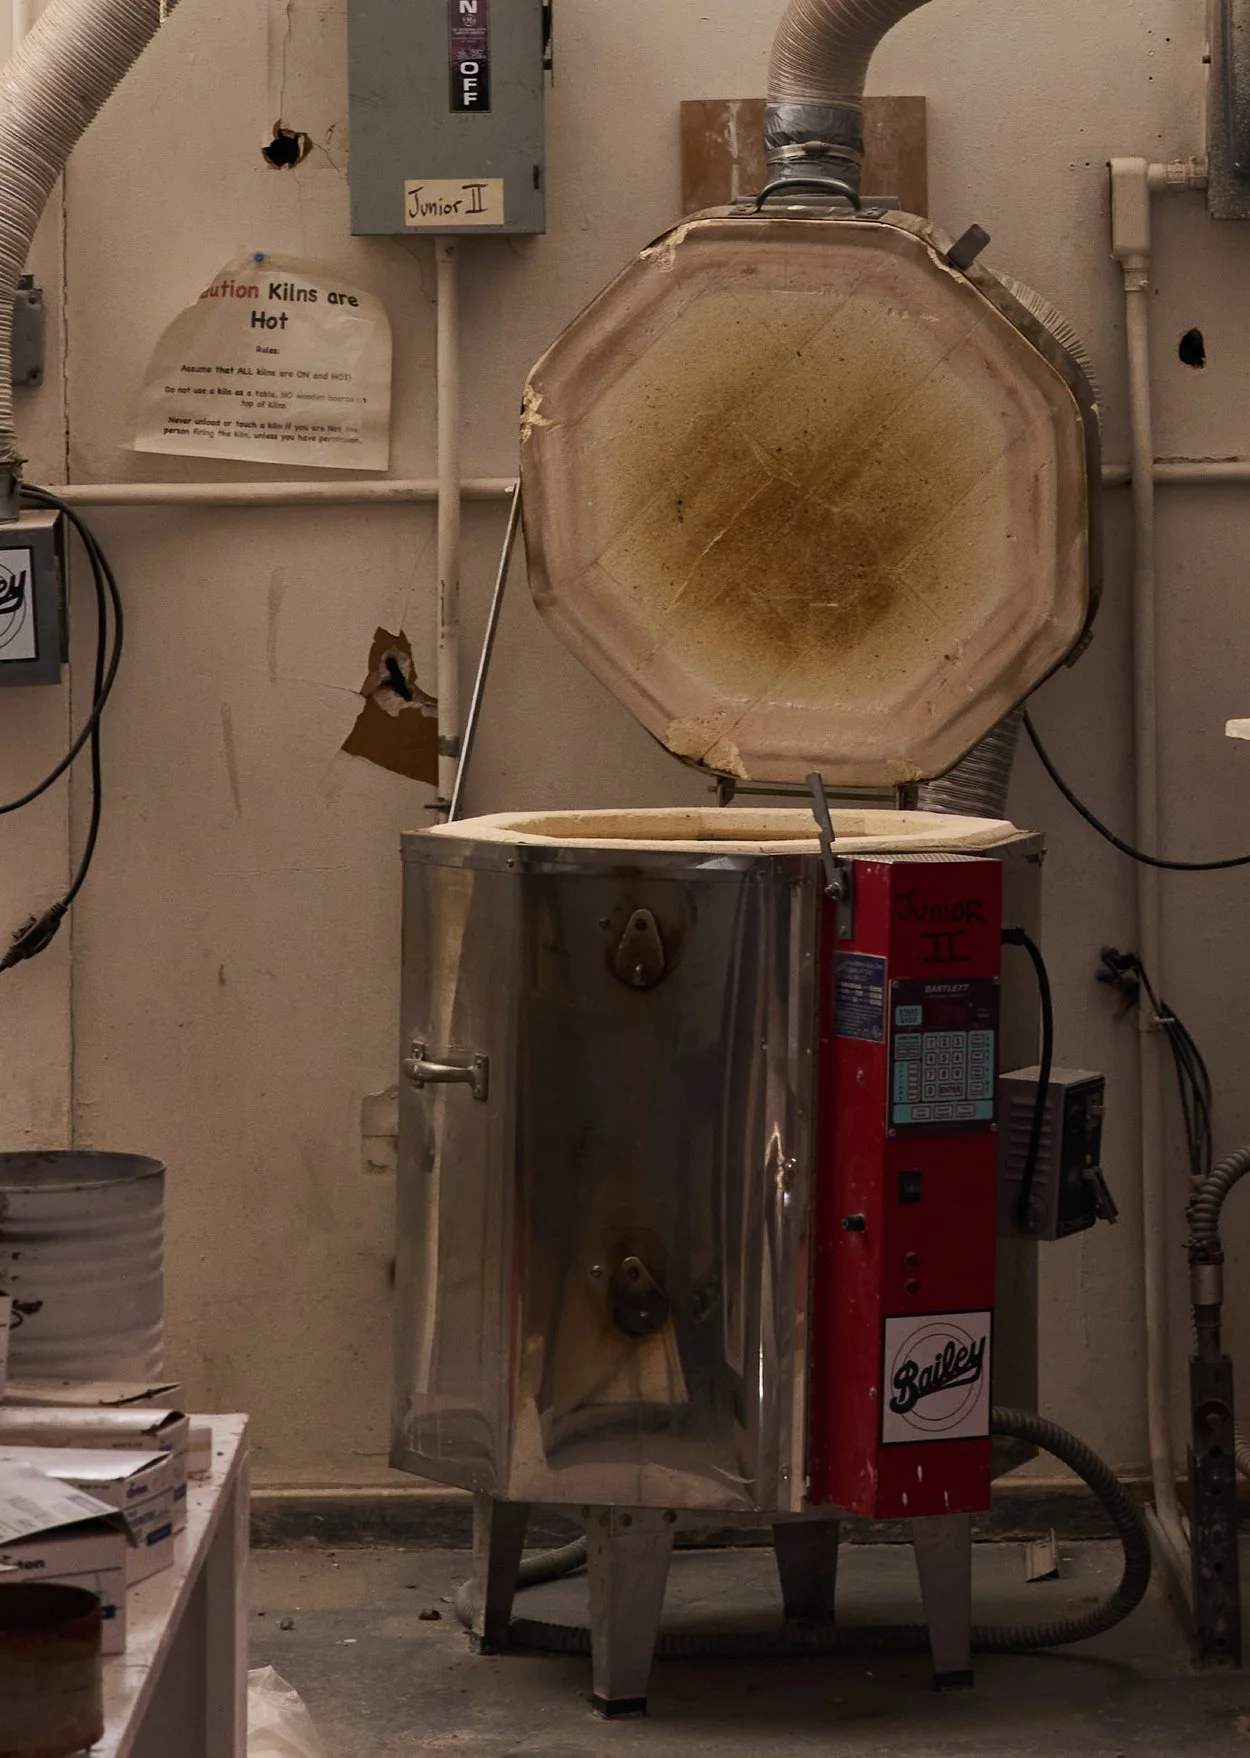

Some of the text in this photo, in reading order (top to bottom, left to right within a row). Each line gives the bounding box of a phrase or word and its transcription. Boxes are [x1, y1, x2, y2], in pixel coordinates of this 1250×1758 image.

[459, 0, 478, 14] N
[460, 61, 480, 106] OFF
[407, 184, 489, 218] Junior II
[201, 279, 360, 308] aution Kilns are
[251, 310, 289, 330] Hot
[181, 364, 213, 374] Assume
[216, 366, 234, 375] that
[237, 367, 254, 376] ALL
[256, 367, 276, 377] kilns
[296, 370, 311, 379] ON
[312, 372, 329, 380] and
[164, 385, 176, 394] Do
[217, 387, 233, 396] kiln
[281, 391, 293, 400] NO
[240, 400, 254, 409] top
[256, 400, 266, 408] of
[168, 416, 192, 425] Never
[194, 418, 221, 427] unload
[235, 420, 258, 429] touch
[267, 422, 283, 430] kiln
[284, 422, 292, 430] if
[163, 427, 190, 436] person
[218, 429, 231, 437] the
[253, 432, 278, 440] unless
[281, 434, 295, 442] you
[297, 433, 317, 442] have
[920, 929, 972, 963] II
[924, 983, 970, 993] BARTLETT
[889, 1335, 986, 1414] Bailey
